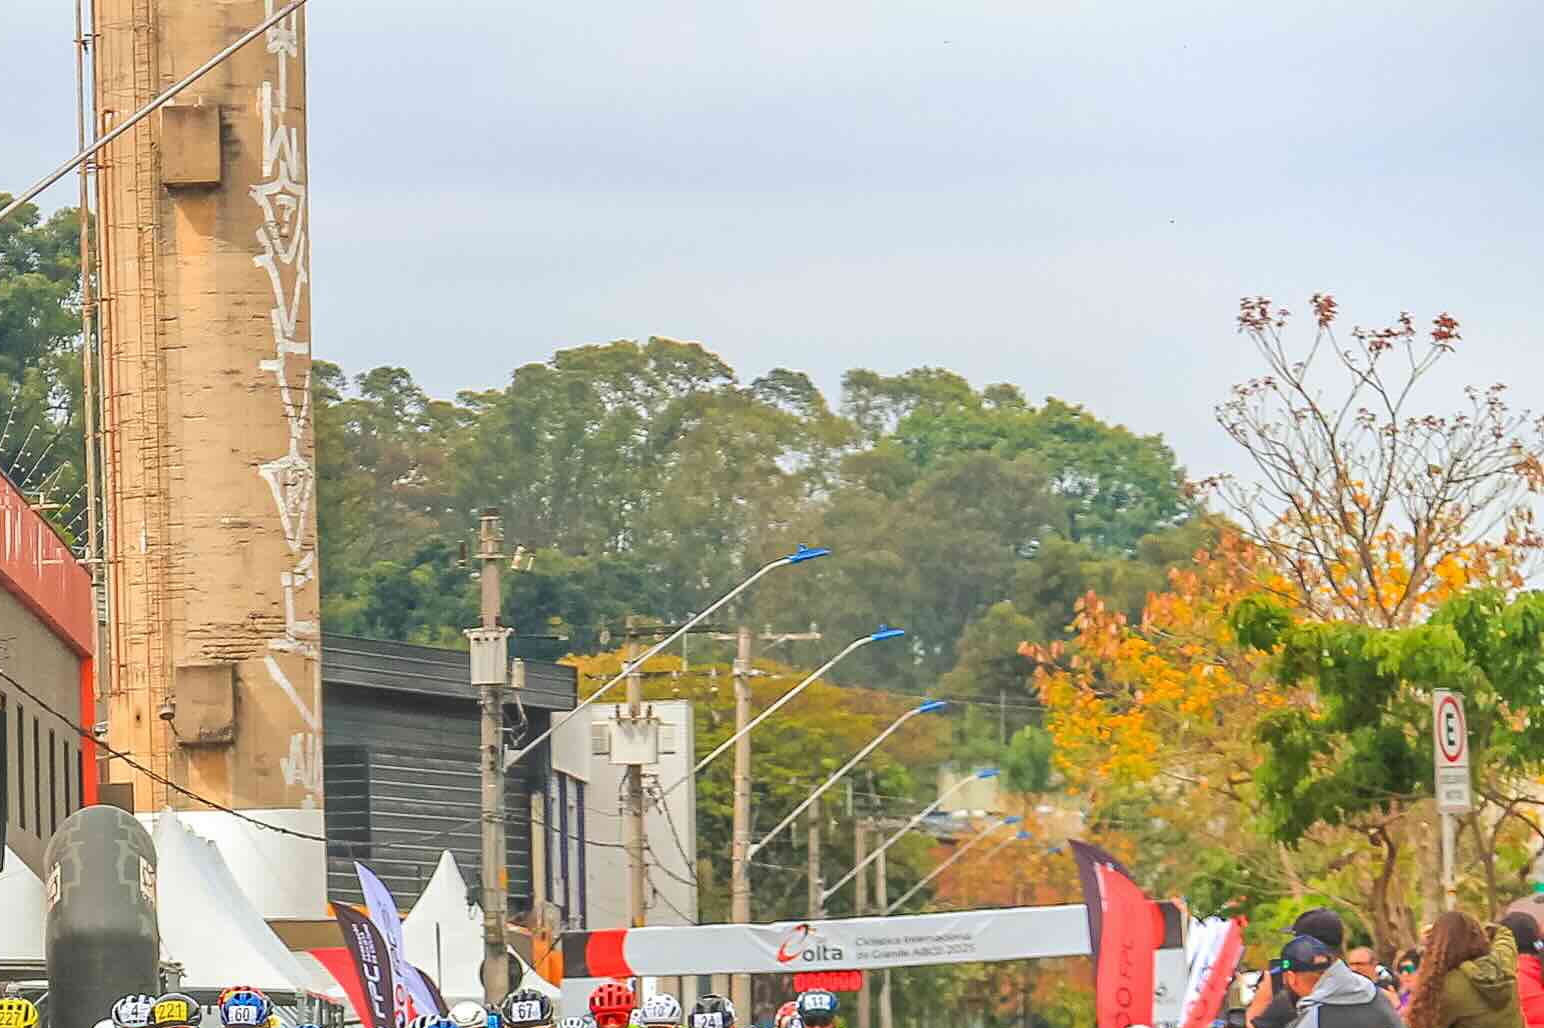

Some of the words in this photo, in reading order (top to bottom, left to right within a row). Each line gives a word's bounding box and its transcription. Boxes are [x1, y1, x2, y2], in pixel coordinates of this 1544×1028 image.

[1445, 712, 1456, 746] E
[159, 1004, 183, 1020] 221
[234, 1007, 250, 1022] 60
[517, 1003, 533, 1019] 67
